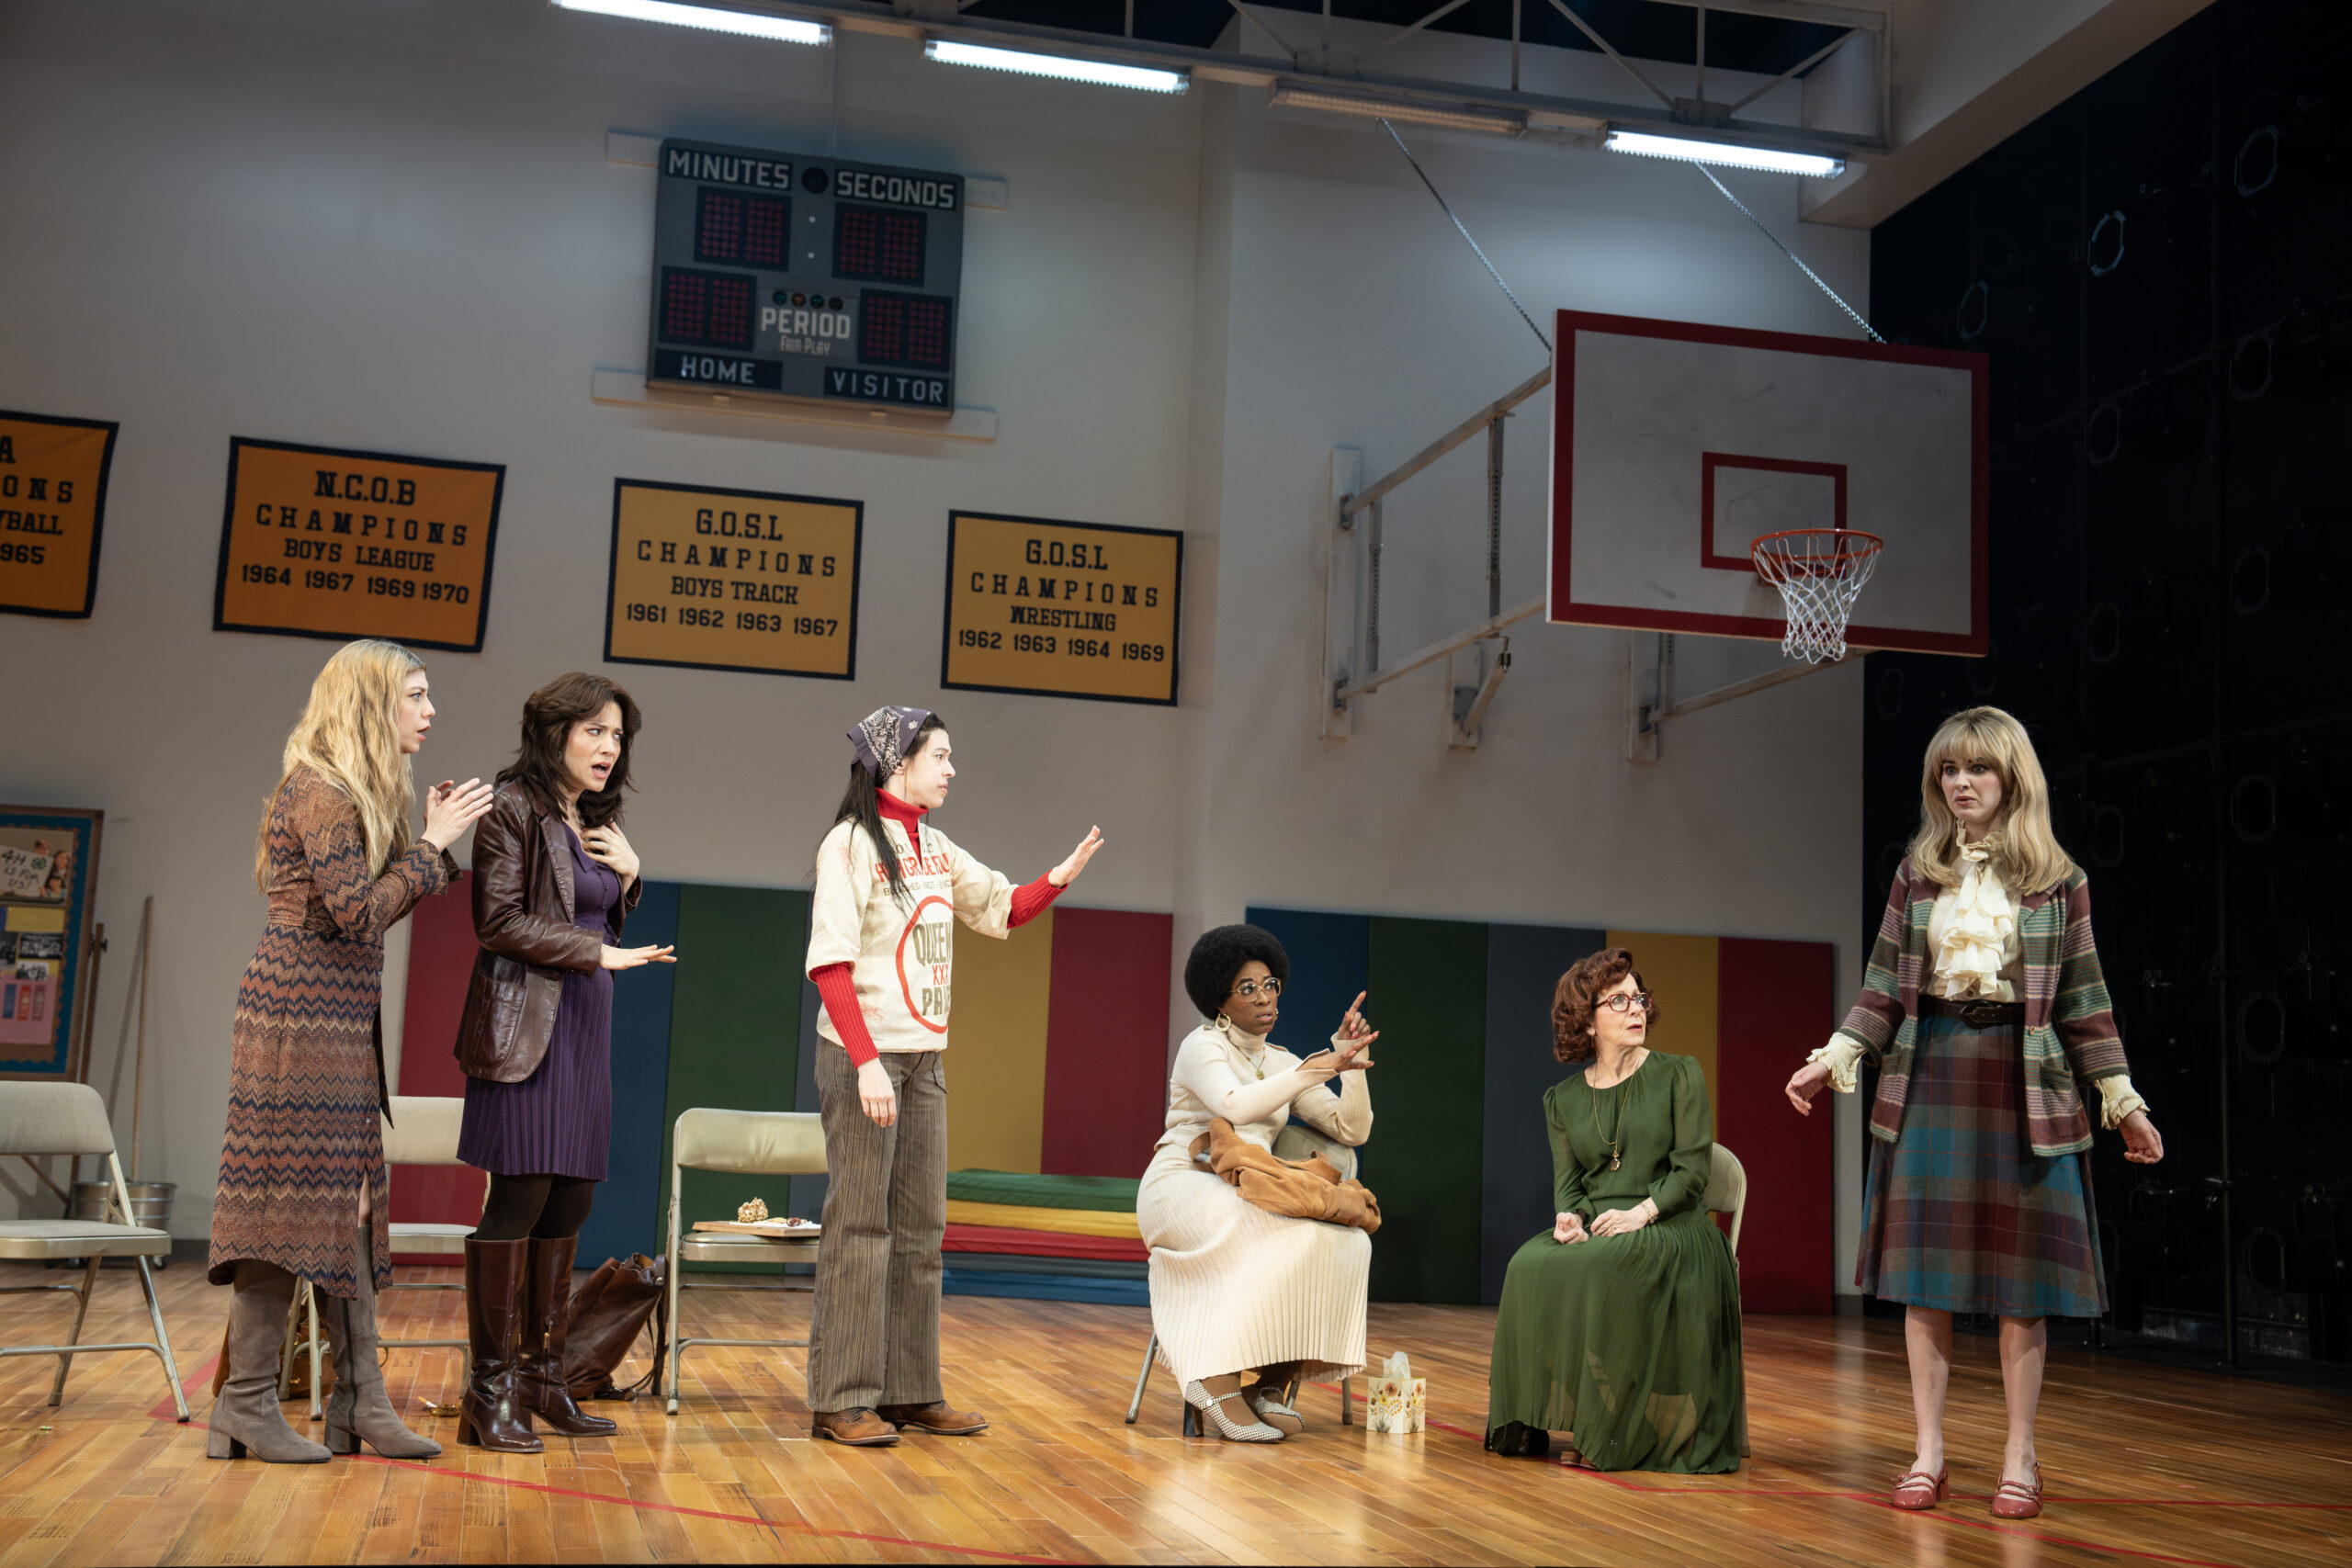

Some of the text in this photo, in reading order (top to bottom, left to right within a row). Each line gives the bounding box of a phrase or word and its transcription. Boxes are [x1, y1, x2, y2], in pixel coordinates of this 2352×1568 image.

[668, 150, 789, 189] MINUTES
[837, 171, 954, 209] SECONDS
[761, 306, 852, 340] PERIOD
[681, 355, 755, 385] HOME
[832, 371, 944, 403] VISITOR
[314, 470, 416, 507] N.C.O.B
[256, 503, 468, 547] CHAMPIONS
[696, 508, 784, 542] G.O.S.L
[283, 537, 435, 571] BOYS LEAGUE
[638, 539, 836, 578] CHAMPIONS
[1025, 539, 1109, 571] G.O.S.L
[242, 564, 469, 604] 1964 1967 1969 1970
[671, 575, 799, 605] BOYS TRACK
[971, 572, 1159, 608] CHAMPIONS
[627, 603, 839, 637] 1961 1962 1963 1967
[1010, 604, 1117, 633] WRESTLING
[958, 628, 1165, 662] 1962 1963 1964 1969
